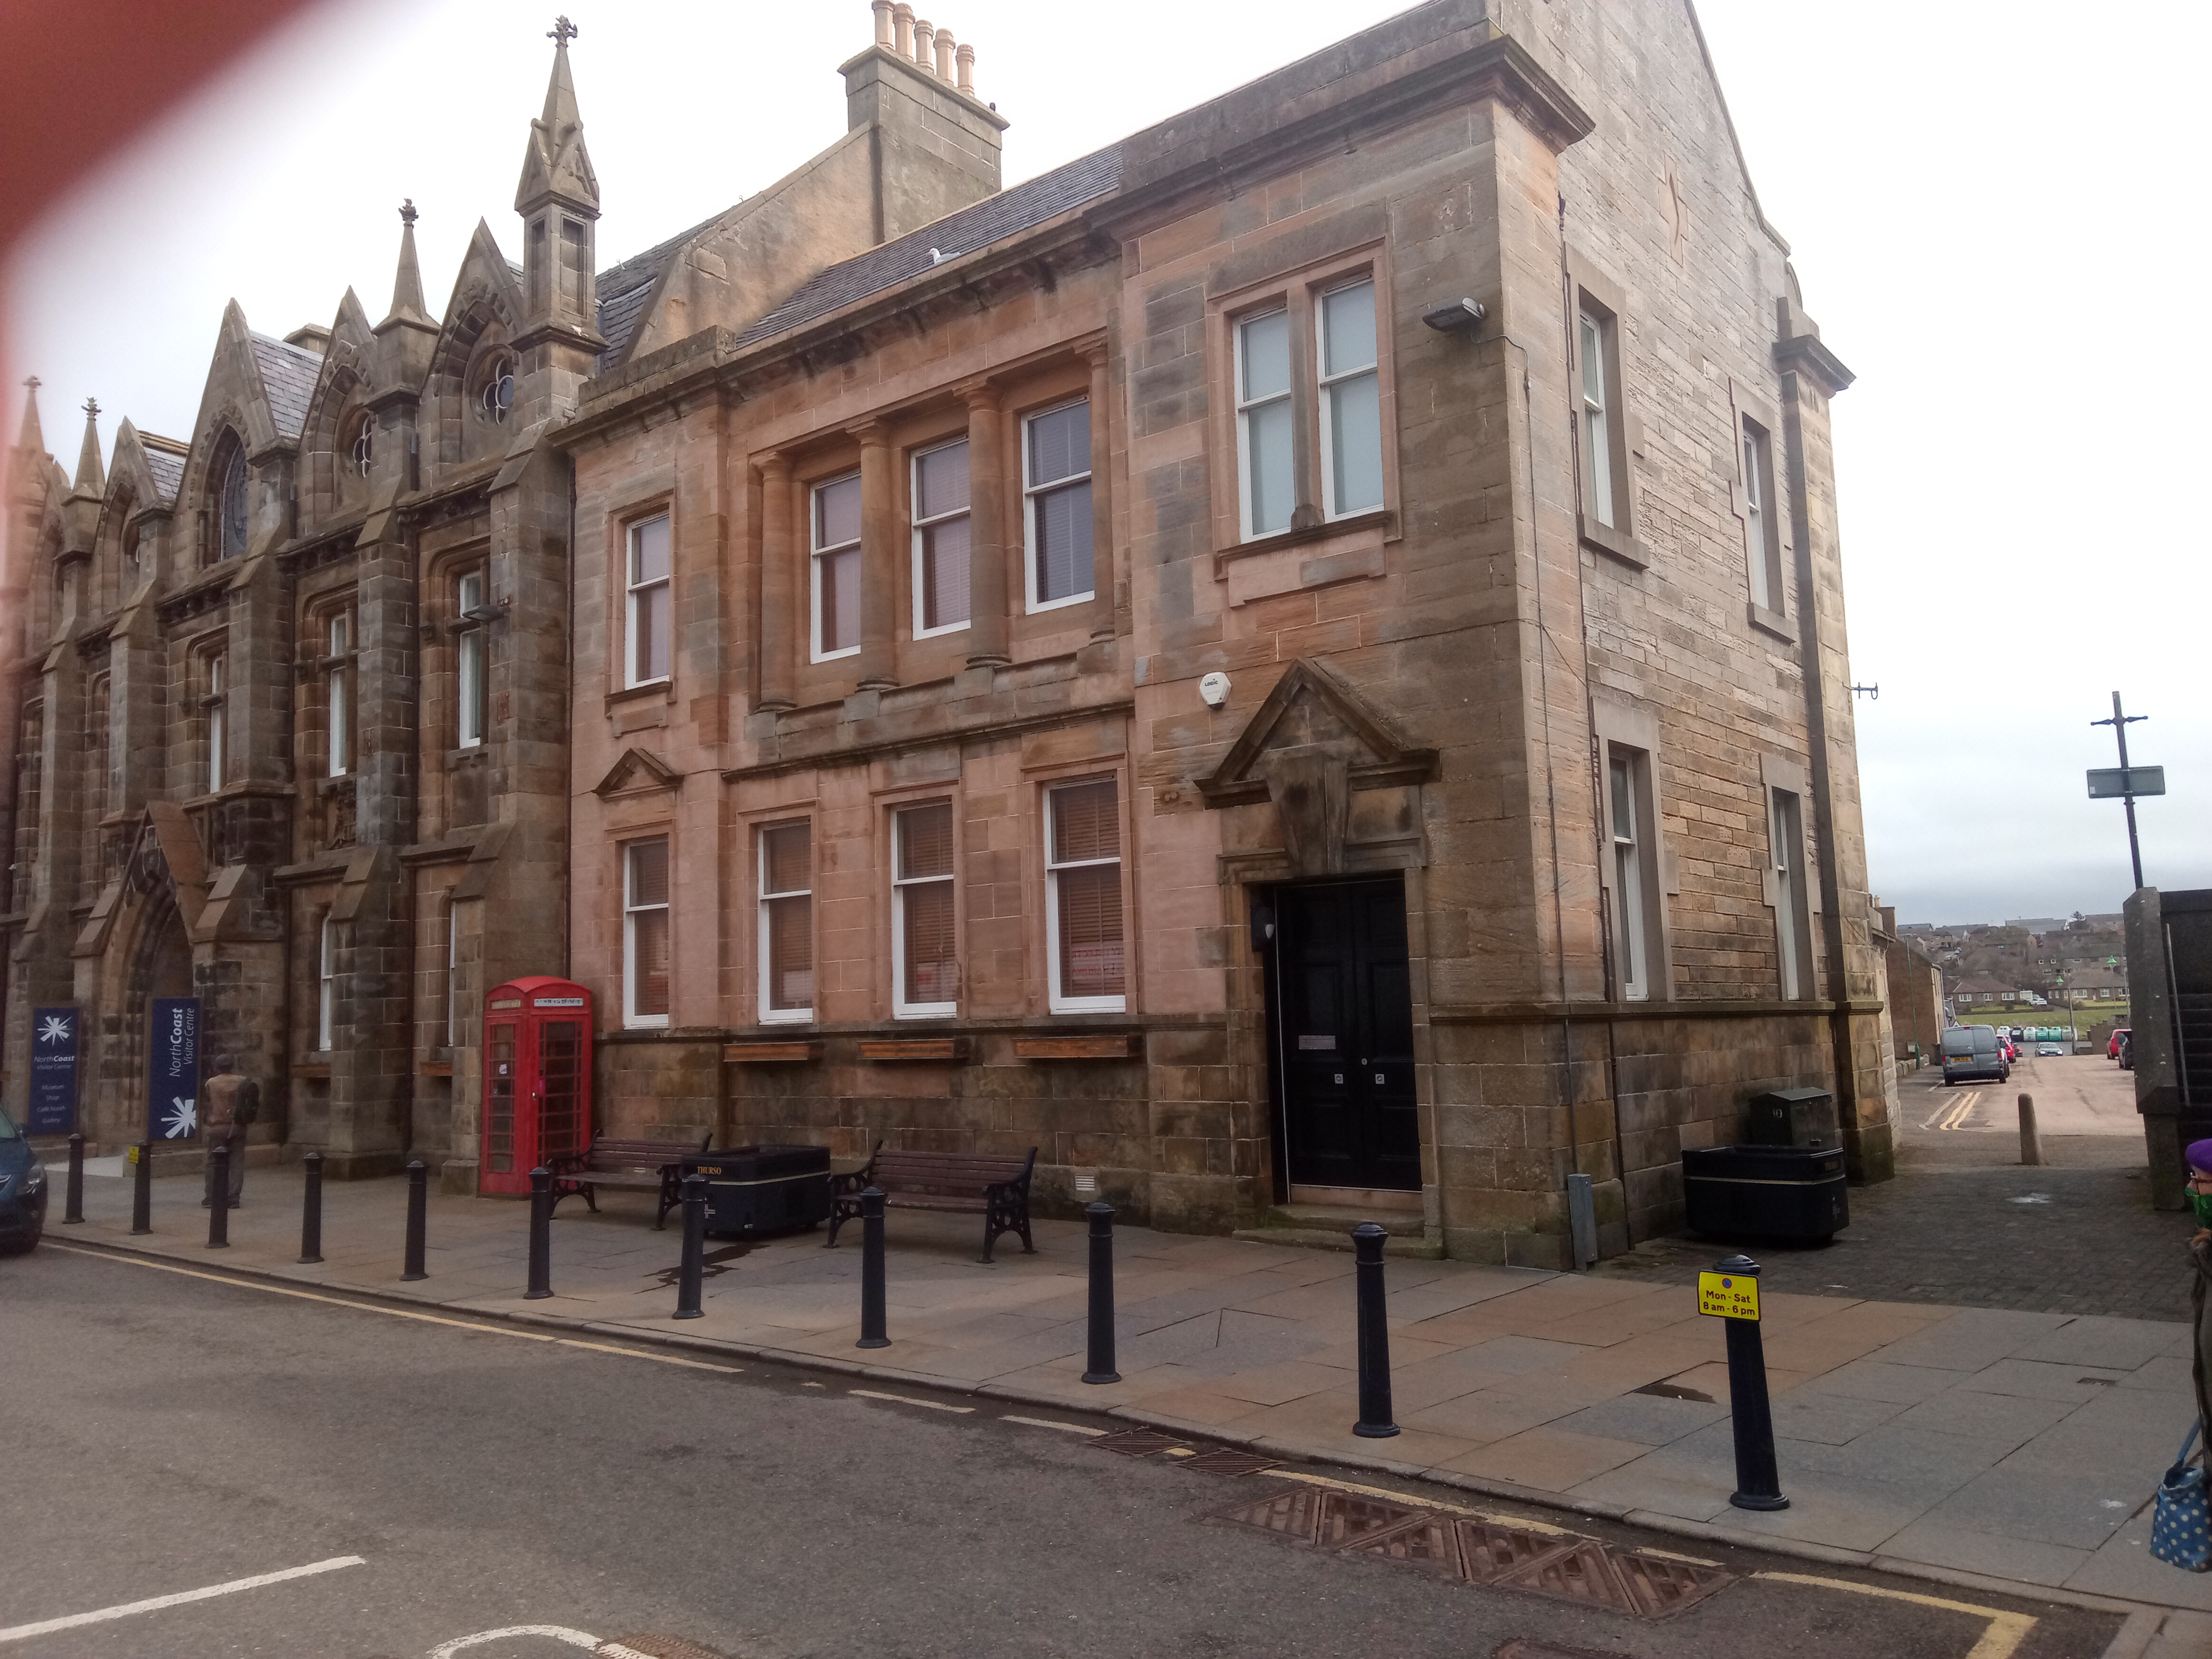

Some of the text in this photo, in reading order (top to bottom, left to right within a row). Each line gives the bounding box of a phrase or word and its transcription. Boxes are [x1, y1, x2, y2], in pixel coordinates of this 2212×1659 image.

[168, 1008, 183, 1077] NorthCoast
[183, 1008, 194, 1065] Visitor Centre
[697, 1166, 721, 1175] THURSO
[1706, 1290, 1726, 1300] Mon
[1733, 1293, 1751, 1303] Sat
